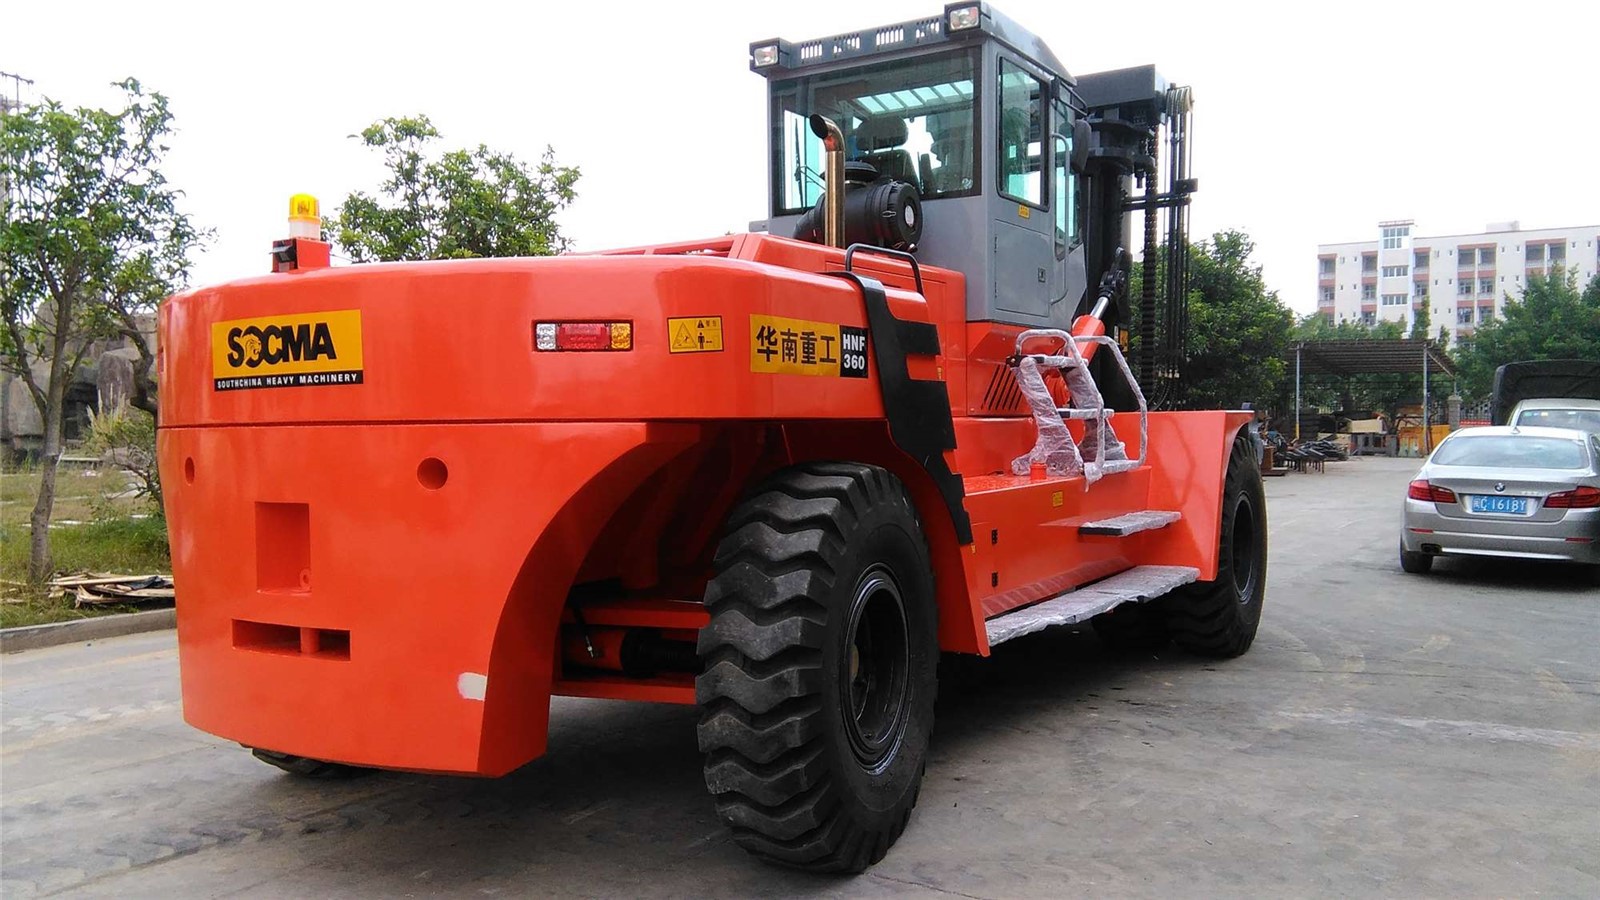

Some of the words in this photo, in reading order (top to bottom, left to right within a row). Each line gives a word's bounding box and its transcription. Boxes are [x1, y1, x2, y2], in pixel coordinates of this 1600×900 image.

[227, 322, 337, 368] SOCMA
[756, 325, 837, 365] 华南重工
[842, 333, 866, 352] HNF
[843, 354, 866, 370] 360
[217, 377, 262, 389] SOUTHCHINA
[266, 376, 294, 385] HEAVY
[299, 373, 357, 384] MACHINERY
